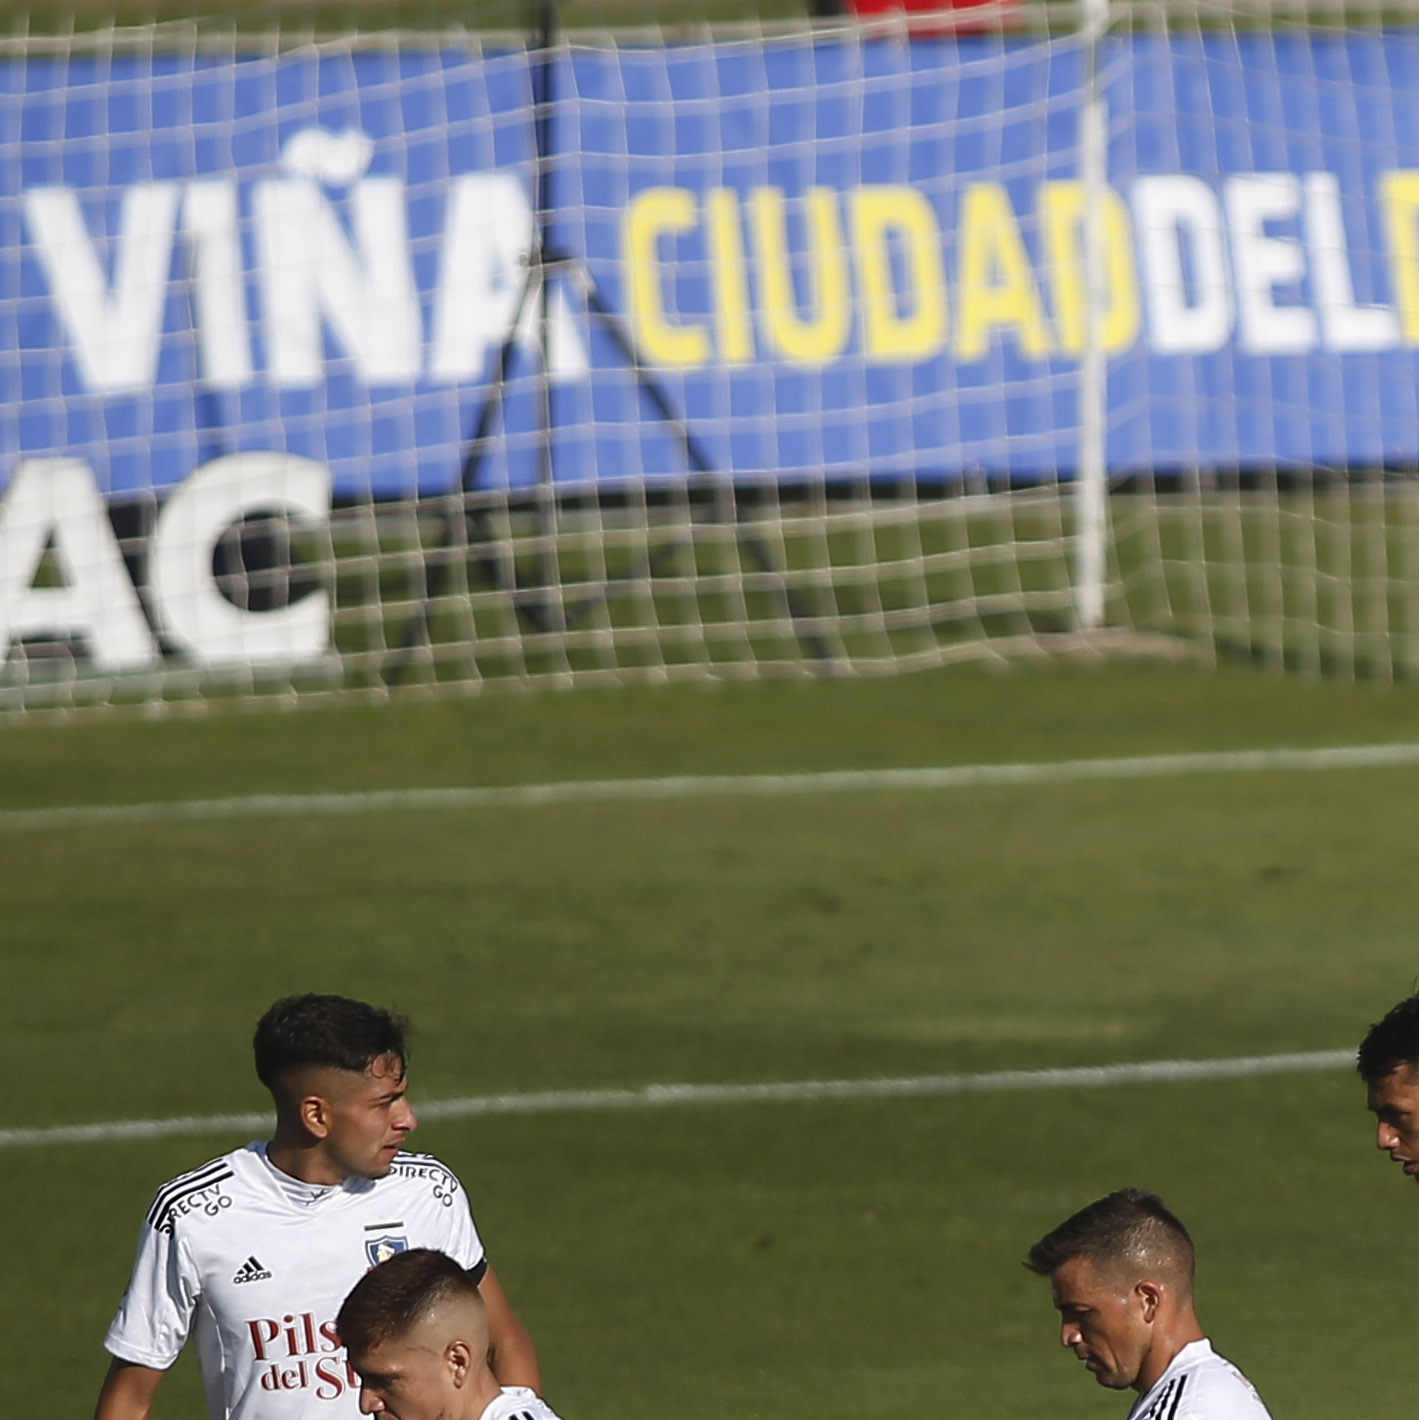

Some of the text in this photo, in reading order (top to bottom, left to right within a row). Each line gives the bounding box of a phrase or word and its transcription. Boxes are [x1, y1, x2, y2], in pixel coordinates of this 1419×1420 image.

[26, 126, 590, 394] VIÑA
[203, 1195, 233, 1217] GO
[432, 1184, 453, 1207] GO
[233, 1271, 272, 1285] adidas
[245, 1312, 344, 1361] Pils
[260, 1360, 311, 1392] del
